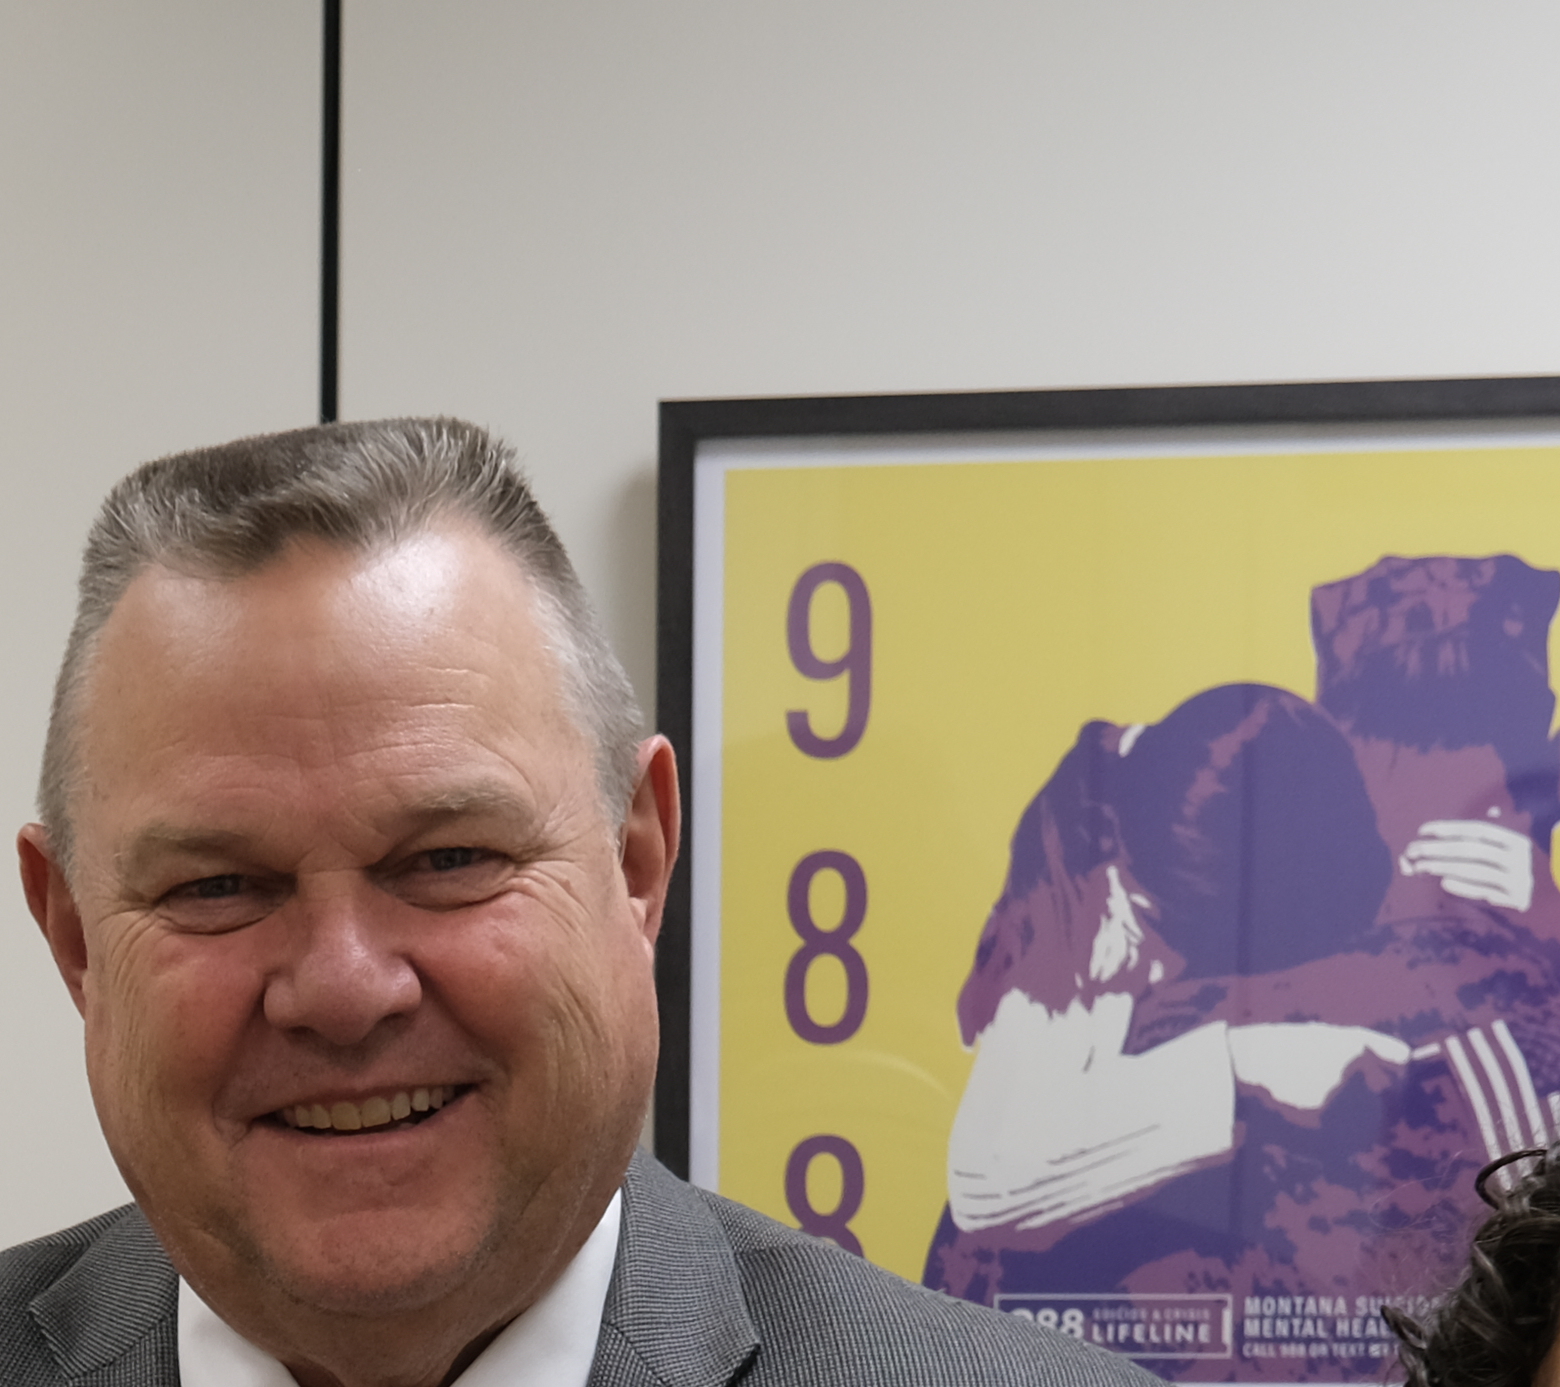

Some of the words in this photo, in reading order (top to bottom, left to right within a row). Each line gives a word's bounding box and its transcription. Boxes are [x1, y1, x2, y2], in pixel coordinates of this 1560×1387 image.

[1245, 1296, 1348, 1316] MONTANA
[1092, 1323, 1210, 1343] LIFELINE
[1244, 1317, 1328, 1338] MENTAL
[1336, 1317, 1394, 1338] HEAL
[1243, 1343, 1277, 1358] CALL
[1333, 1342, 1365, 1357] TEXT
